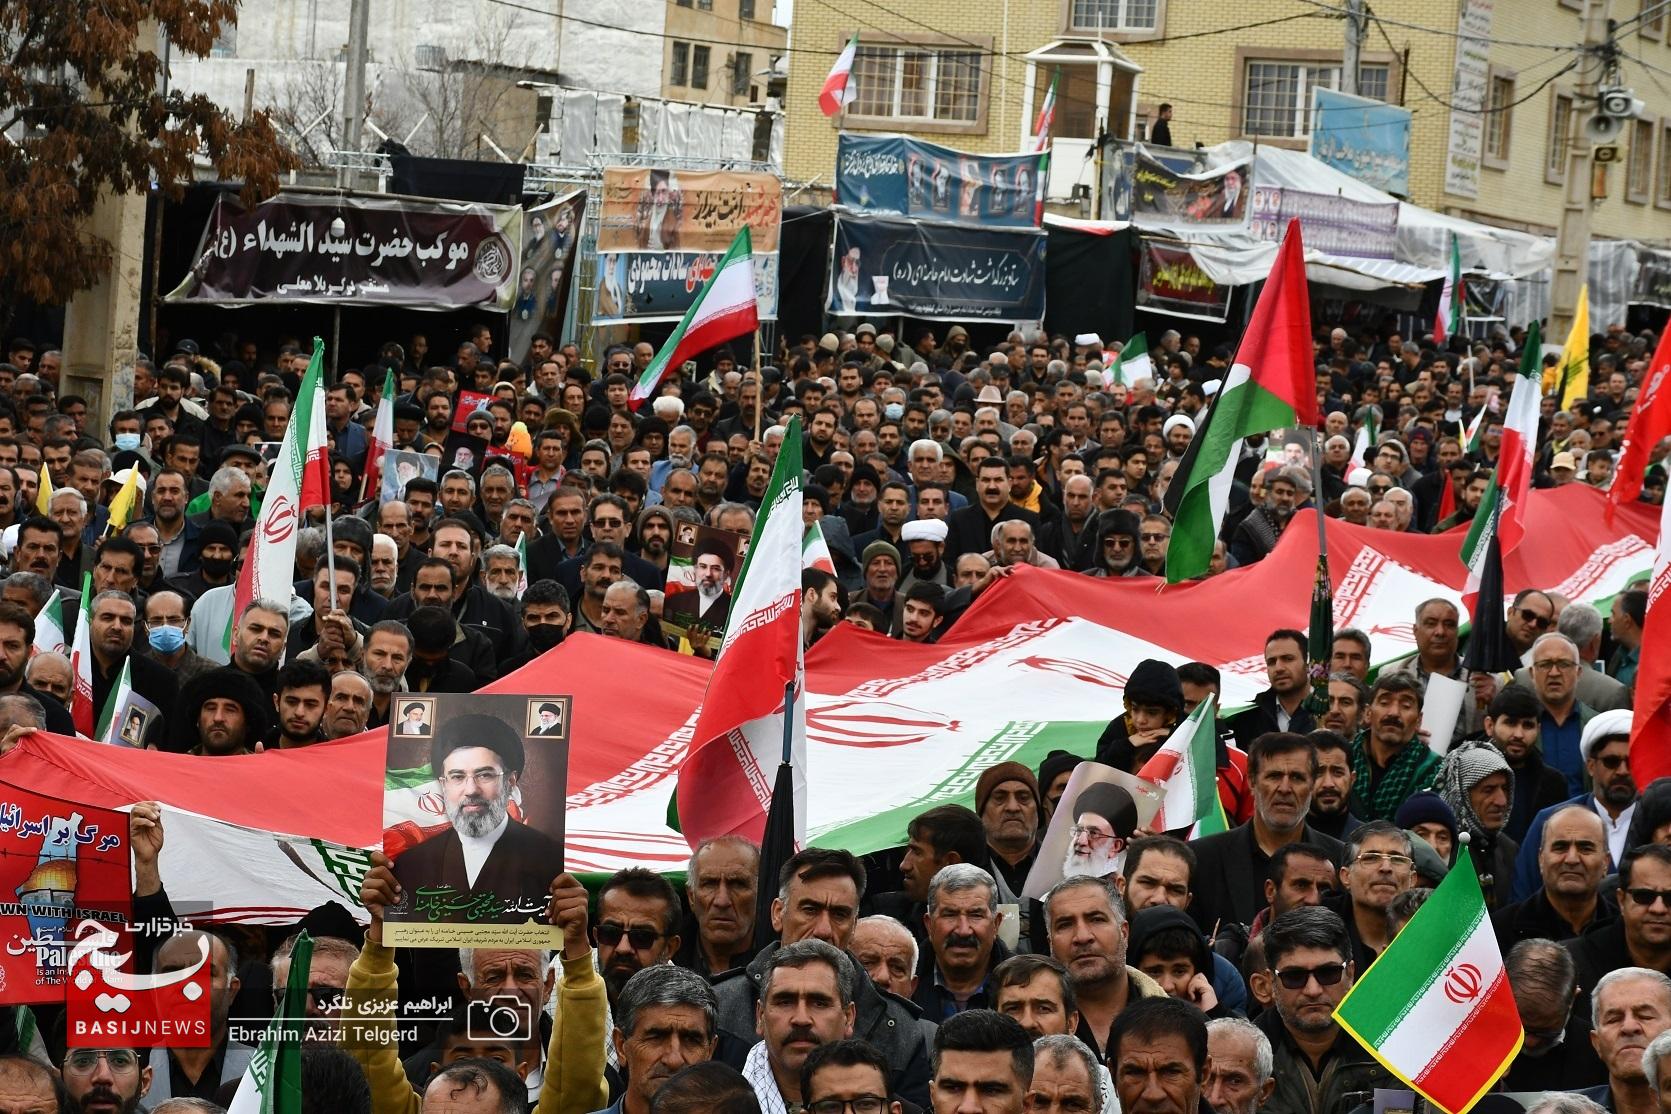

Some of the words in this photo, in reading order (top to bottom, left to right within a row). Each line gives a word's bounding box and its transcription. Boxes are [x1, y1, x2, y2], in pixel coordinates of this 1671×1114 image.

[243, 219, 314, 259] الشهداء
[355, 227, 414, 267] حضرت
[415, 230, 469, 270] موکب
[893, 260, 912, 282] (ره)
[950, 259, 975, 283] شهادت
[276, 274, 313, 295] معلی
[313, 274, 347, 296] کربلا
[52, 825, 71, 846] بر
[74, 823, 120, 852] مرگ
[0, 902, 29, 917] WN
[31, 904, 73, 919] WITH
[76, 908, 129, 924] ISRAEL
[467, 889, 498, 921] مجتبی
[518, 928, 534, 936] حضرت
[35, 976, 45, 985] of
[45, 976, 61, 985] The
